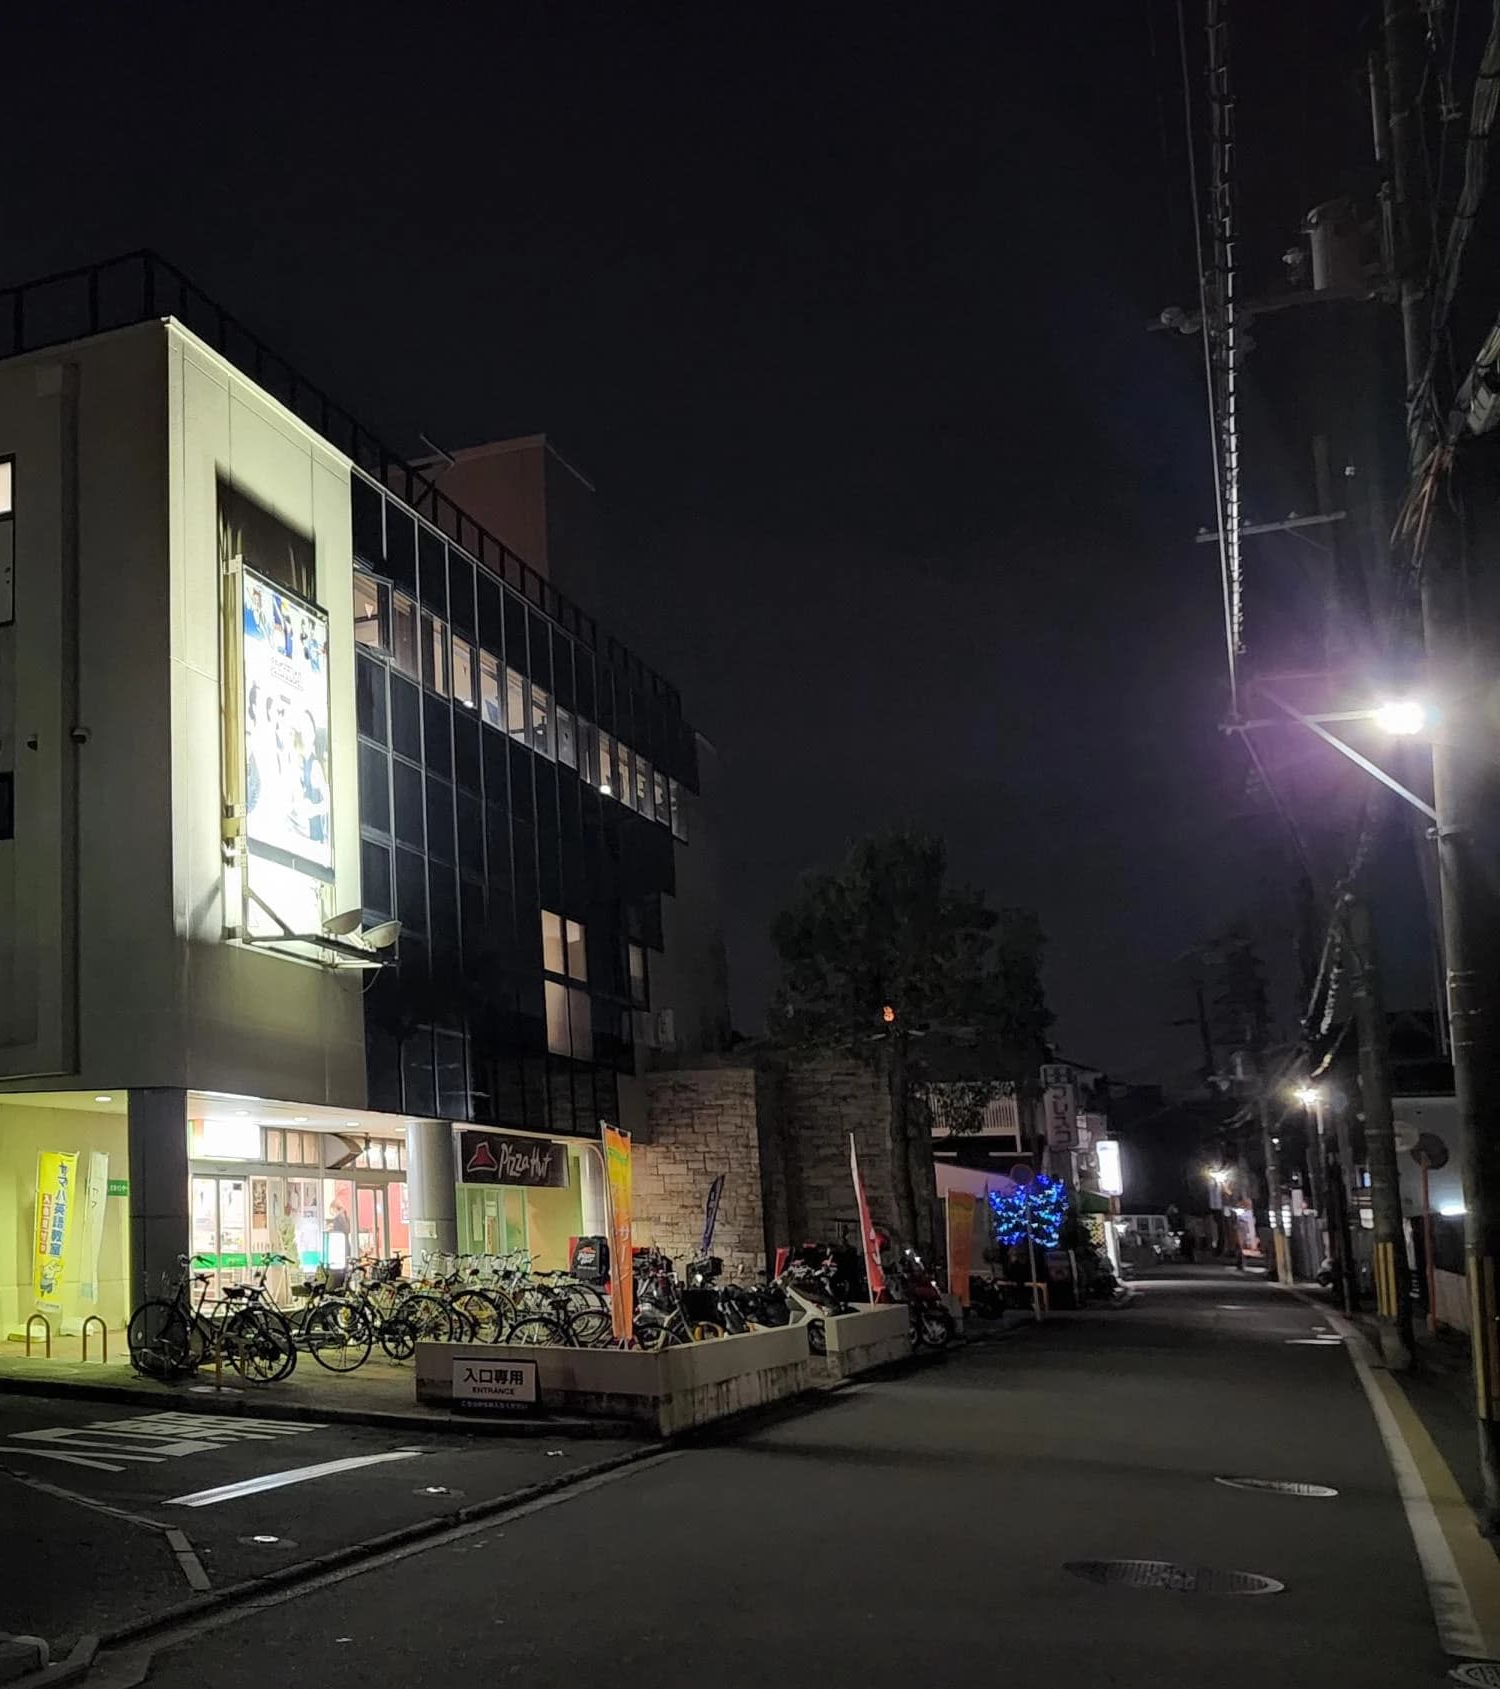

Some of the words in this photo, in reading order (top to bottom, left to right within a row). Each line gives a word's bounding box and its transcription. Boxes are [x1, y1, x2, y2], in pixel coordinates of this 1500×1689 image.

[499, 1142, 530, 1179] Pizza
[530, 1145, 552, 1177] Hut
[50, 1162, 68, 1256] ヤマハ英語教室
[463, 1368, 524, 1385] 入口専用
[472, 1386, 515, 1395] ENTRANCE
